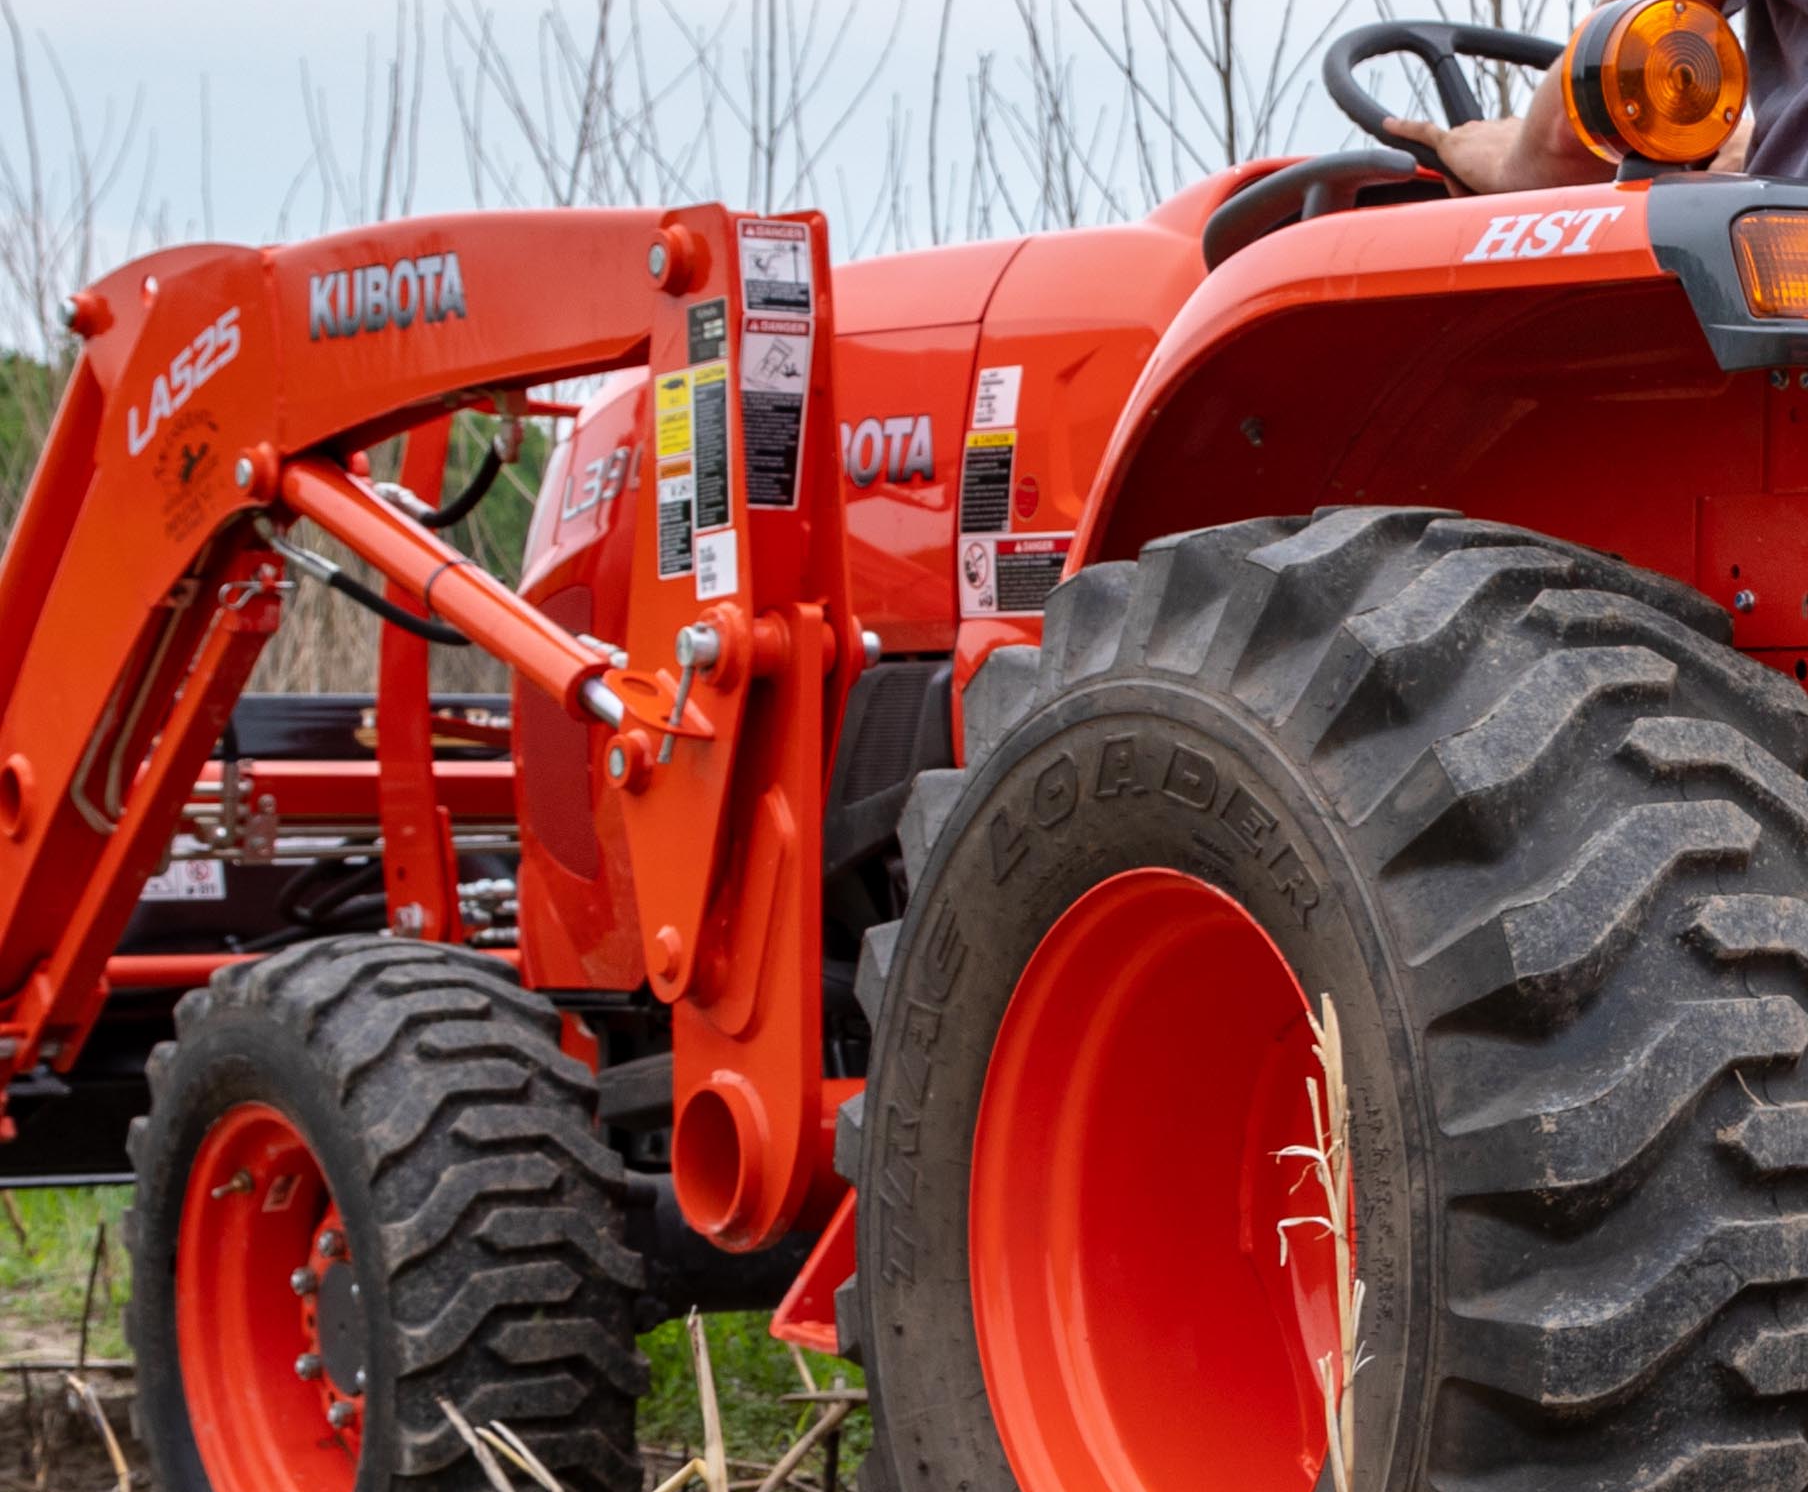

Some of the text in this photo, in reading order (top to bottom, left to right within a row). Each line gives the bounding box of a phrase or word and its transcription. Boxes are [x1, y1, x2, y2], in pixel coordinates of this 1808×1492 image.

[1464, 206, 1624, 261] HST
[309, 252, 467, 342] KUBOTA
[127, 306, 241, 456] LA525
[990, 730, 1321, 932] LOADER
